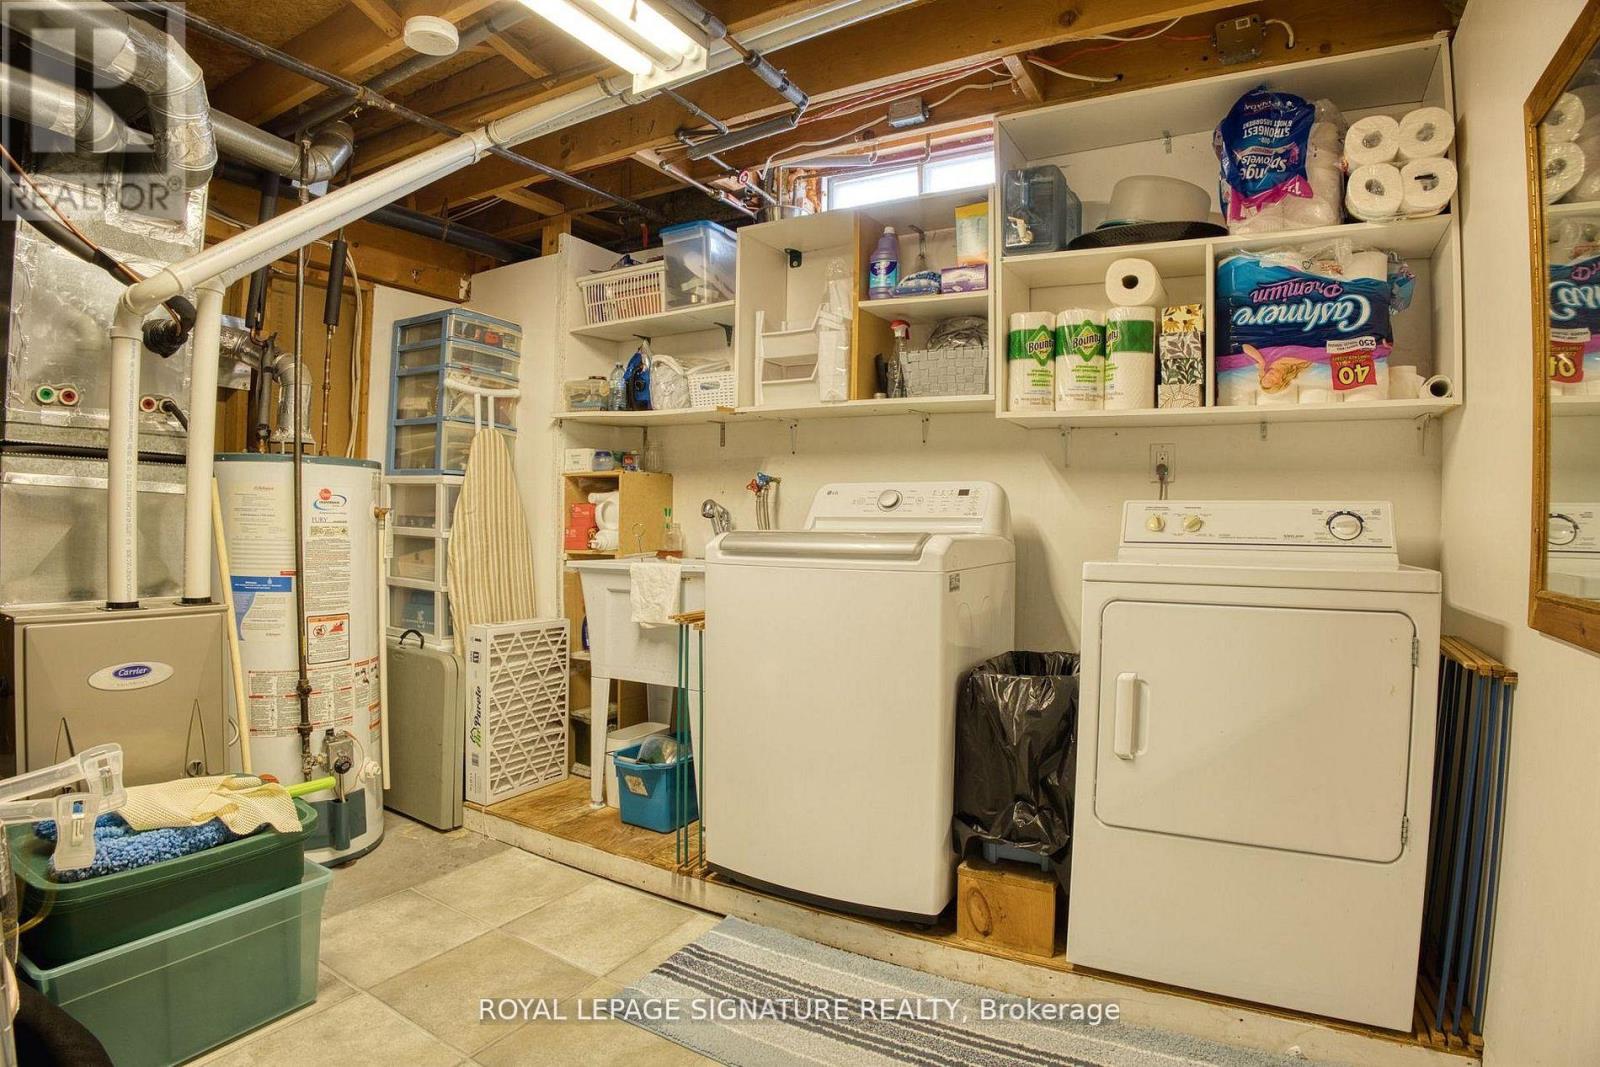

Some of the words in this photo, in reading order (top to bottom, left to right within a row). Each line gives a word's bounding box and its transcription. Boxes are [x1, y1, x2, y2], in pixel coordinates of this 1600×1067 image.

[1243, 125, 1290, 139] STRONGEST
[1251, 280, 1343, 304] Premium
[1233, 293, 1371, 333] Cashmere
[1028, 340, 1055, 354] Bount
[1072, 333, 1102, 349] Bounty
[1359, 339, 1376, 347] 250
[1338, 363, 1370, 385] 40
[118, 667, 148, 677] Carrier
